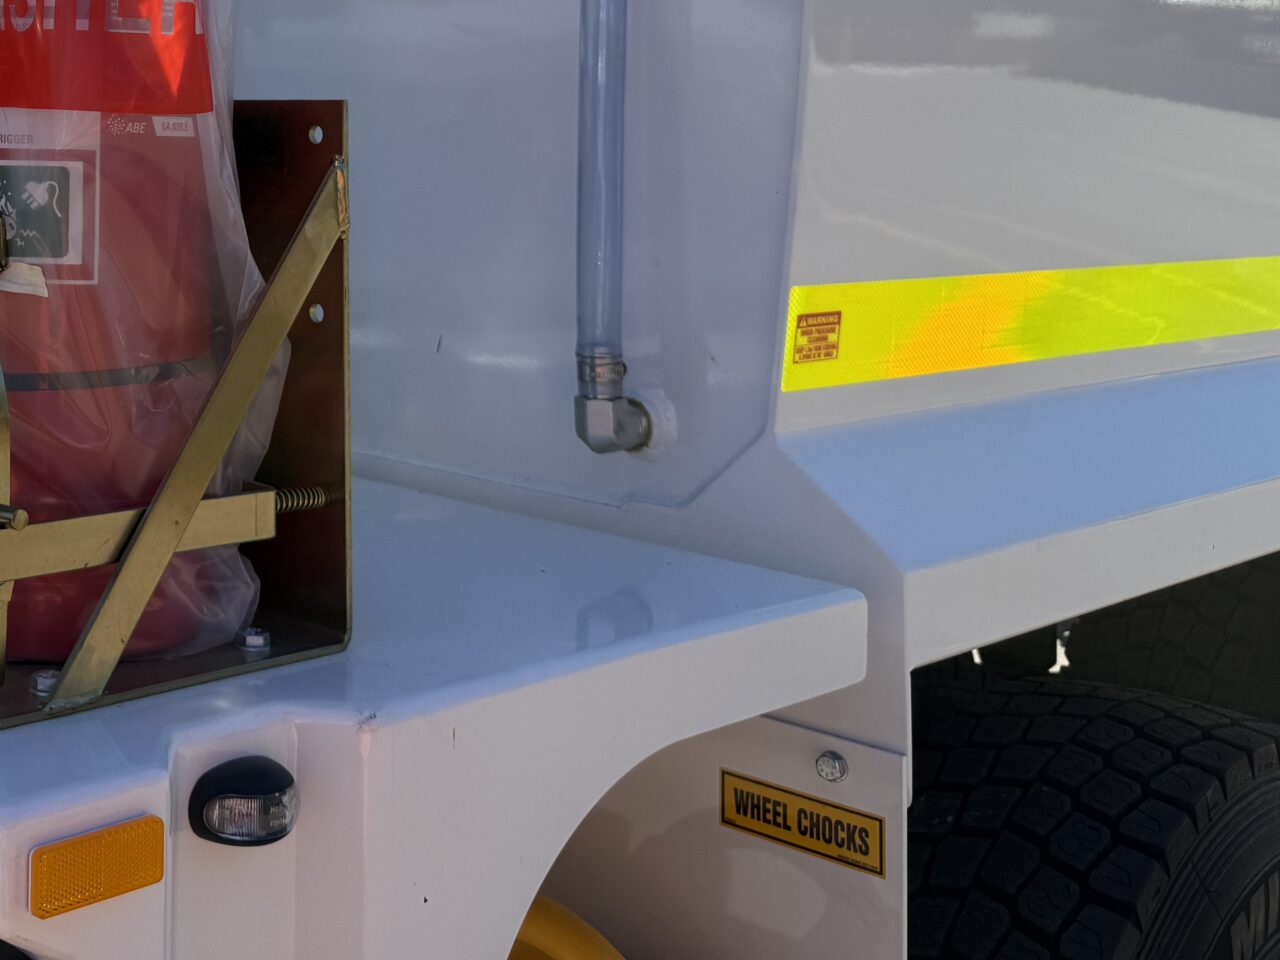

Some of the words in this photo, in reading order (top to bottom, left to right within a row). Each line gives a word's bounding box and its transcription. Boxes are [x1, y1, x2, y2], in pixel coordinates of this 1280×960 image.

[125, 122, 146, 134] ABE
[733, 787, 791, 831] WHEEL
[797, 807, 870, 857] CHOCKS
